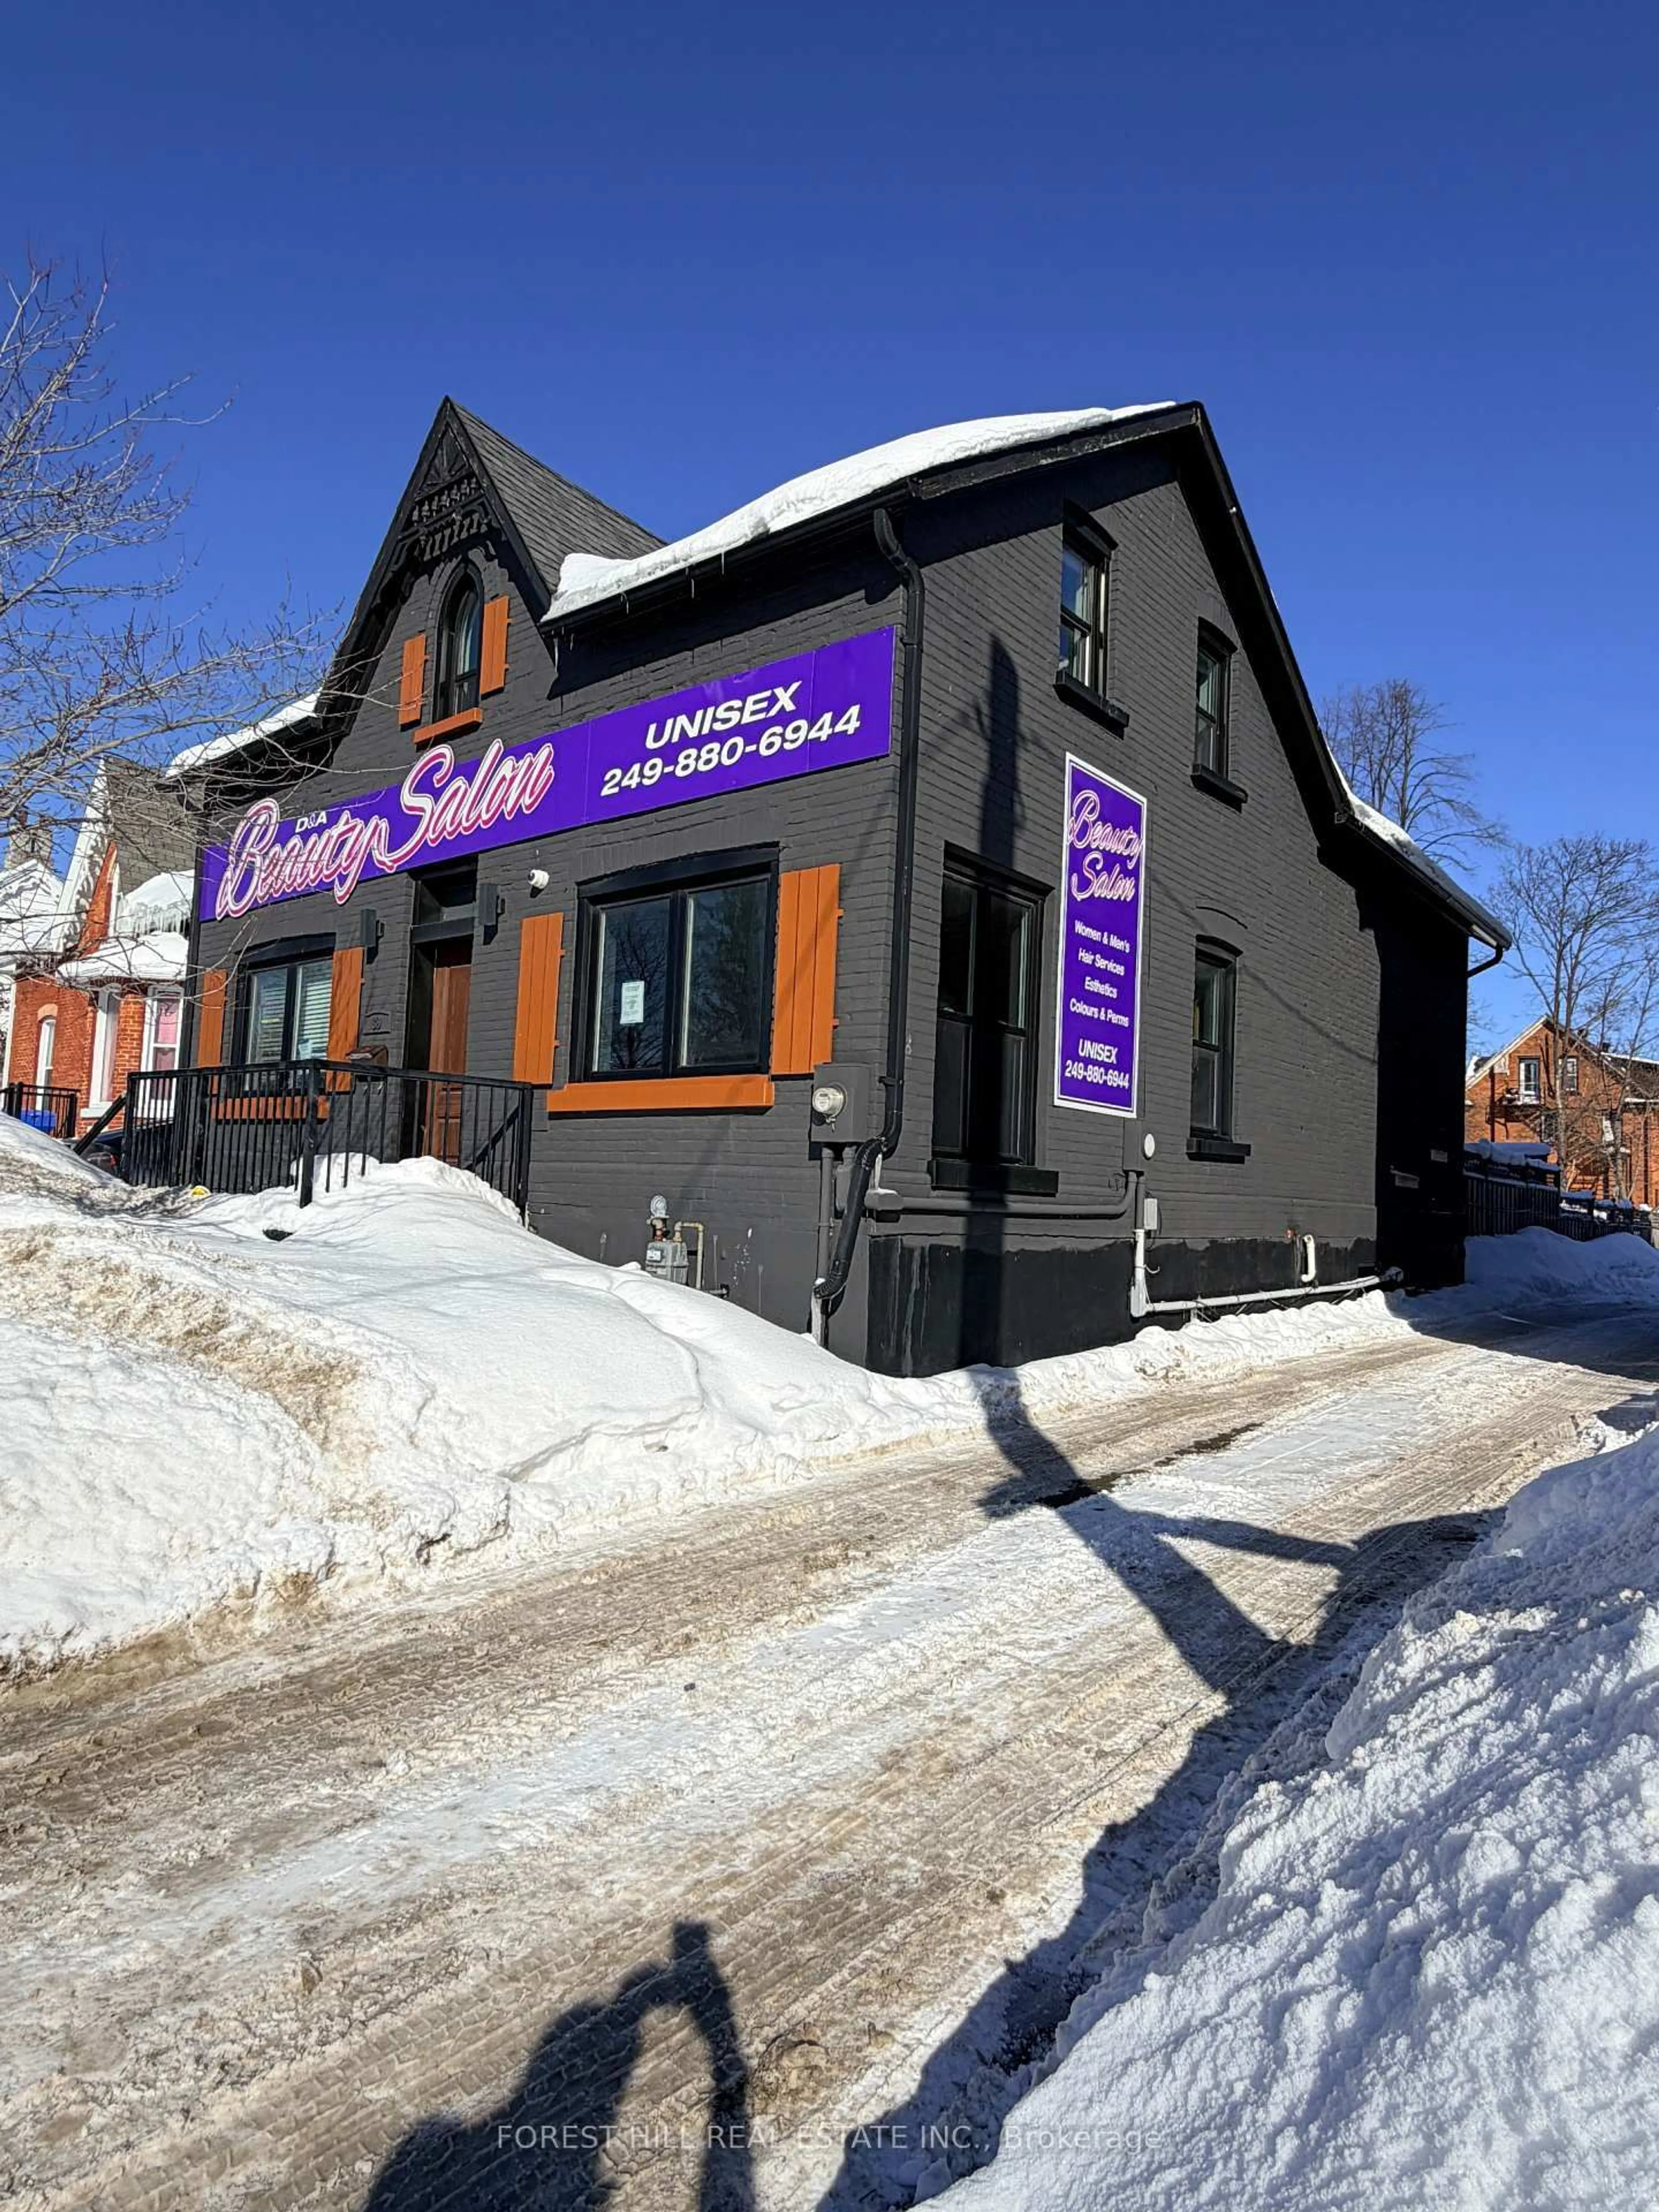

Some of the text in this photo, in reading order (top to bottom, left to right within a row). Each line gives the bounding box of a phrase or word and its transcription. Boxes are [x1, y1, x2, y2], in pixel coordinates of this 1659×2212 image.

[644, 680, 802, 750] UNISEX
[600, 704, 861, 796] 249-880-6944
[216, 738, 555, 922] Beauty Salon
[295, 810, 327, 833] D&A
[1068, 789, 1143, 870] Beauty
[1071, 851, 1136, 902] Salon
[1074, 919, 1130, 953] Women & Men's
[1078, 947, 1125, 976] Hair Services
[1084, 976, 1118, 998] Esthetics
[1070, 998, 1129, 1027] Colours & Perms
[1078, 1038, 1118, 1065] UNISEX
[1065, 1059, 1130, 1090] 249-880-6944
